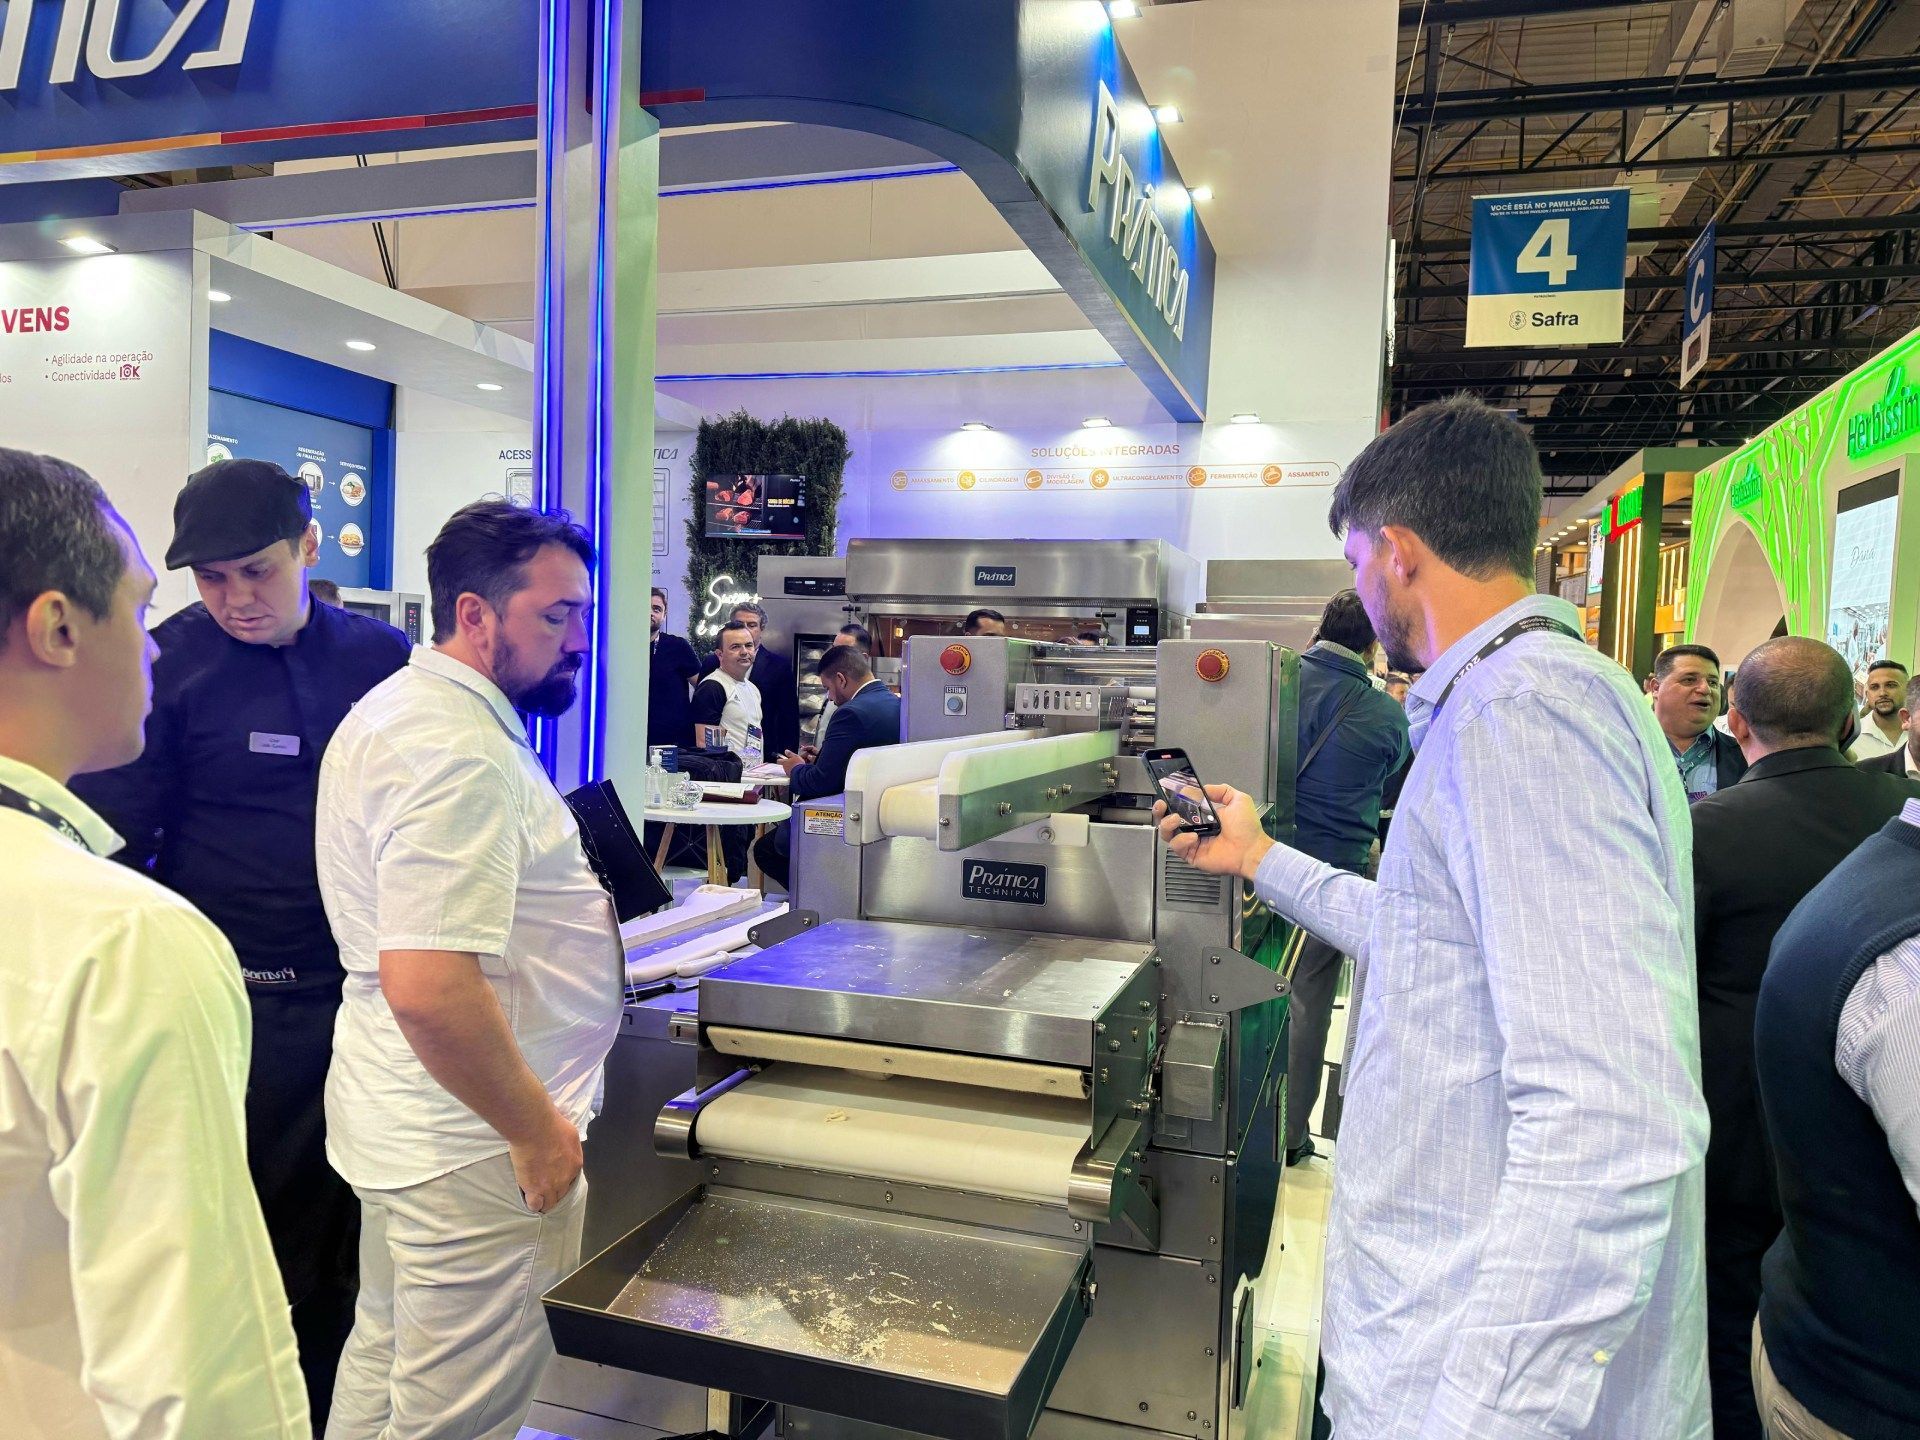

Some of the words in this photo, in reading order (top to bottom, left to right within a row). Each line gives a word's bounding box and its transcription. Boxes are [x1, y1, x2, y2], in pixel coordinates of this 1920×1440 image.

[1490, 202, 1512, 211] VOCÊ
[1513, 201, 1533, 210] ESTÁ
[1548, 198, 1588, 208] PAVILHÃO
[1589, 197, 1610, 205] AZUL
[1516, 218, 1577, 285] 4
[1690, 259, 1705, 323] C
[1, 306, 70, 334] VENS
[1531, 311, 1579, 327] Safra
[52, 353, 93, 366] Agilidade
[95, 355, 107, 363] na
[109, 350, 153, 365] operação
[52, 370, 116, 382] Conectividade
[499, 449, 533, 460] ACESS
[1031, 444, 1096, 460] SOLUÇÕES
[1099, 443, 1180, 456] INTEGRADAS
[1210, 471, 1258, 481] FERMENTAÇÃO
[1287, 470, 1330, 478] ASSAMENTO
[969, 885, 1039, 899] TECHNIPAN
